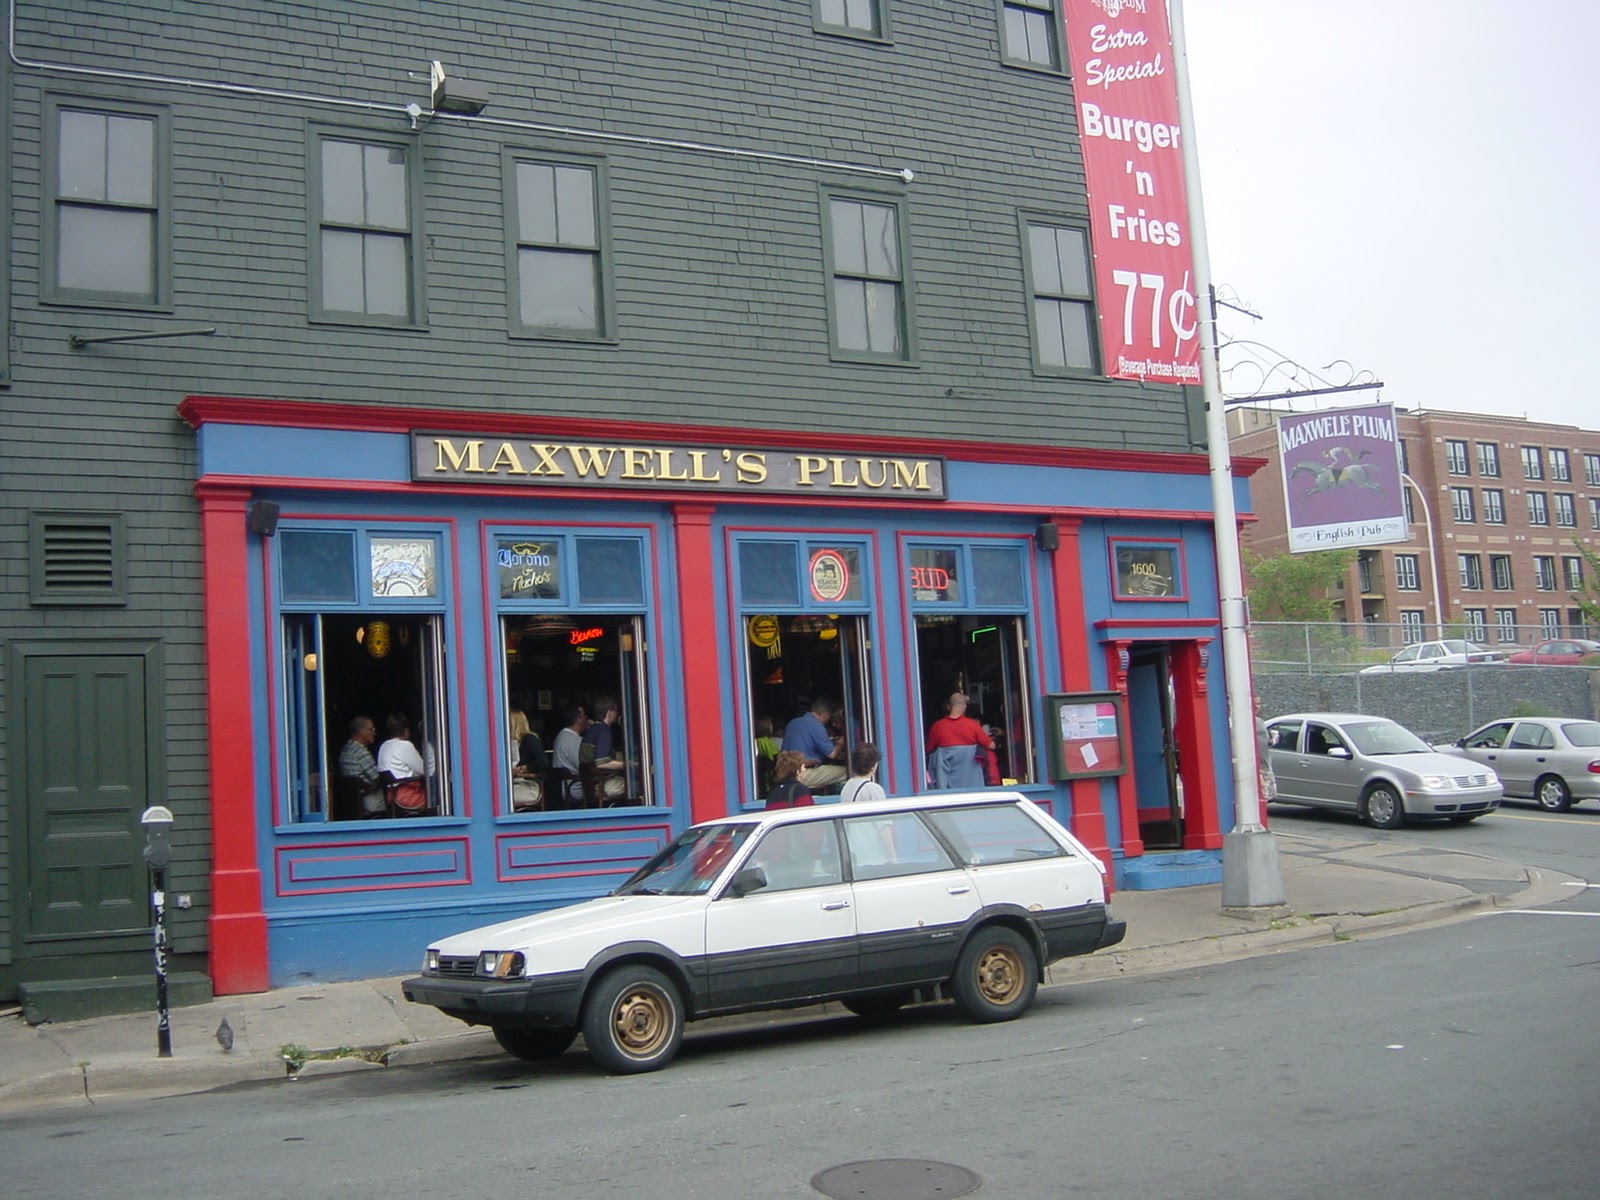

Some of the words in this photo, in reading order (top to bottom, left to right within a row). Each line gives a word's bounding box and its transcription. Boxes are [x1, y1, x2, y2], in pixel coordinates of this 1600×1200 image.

[1090, 24, 1149, 53] Extra
[1085, 52, 1165, 89] Special
[1081, 102, 1181, 153] Burger
[1126, 161, 1154, 197] 'n
[1108, 204, 1181, 247] Fries
[1113, 269, 1198, 357] 77¢
[1118, 355, 1147, 378] (Beverage
[1146, 358, 1173, 377] Purchase
[1172, 360, 1200, 382] Required)
[1352, 415, 1393, 442] PLUM
[434, 438, 768, 483] MAXWELL'S
[794, 454, 932, 491] PLUM
[1314, 527, 1354, 543] English
[1357, 524, 1382, 540] Pub
[498, 549, 551, 568] Corona
[1131, 563, 1156, 576] 1600
[910, 567, 949, 590] BUD
